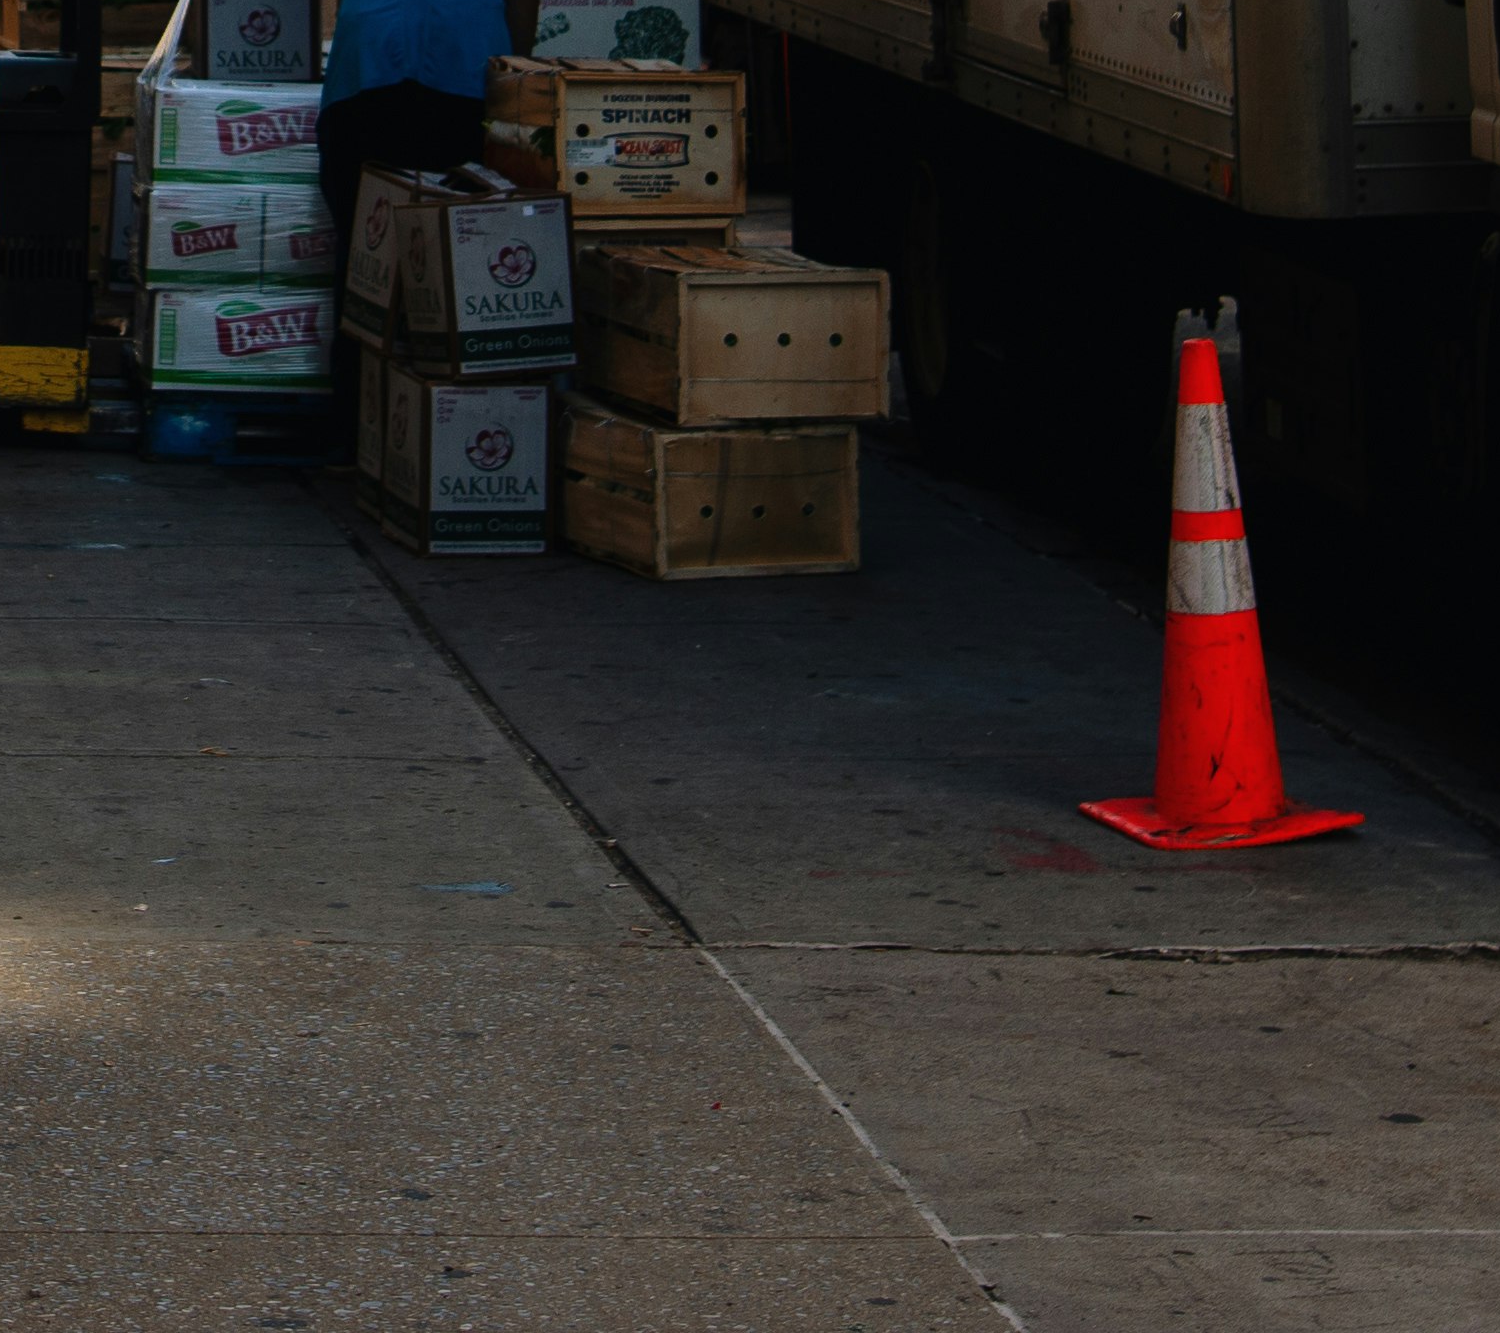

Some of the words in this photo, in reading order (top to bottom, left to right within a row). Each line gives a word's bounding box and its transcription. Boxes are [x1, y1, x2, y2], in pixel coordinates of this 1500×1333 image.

[216, 49, 305, 68] SAKURA
[601, 108, 692, 125] SPINACH
[229, 108, 308, 153] B&W
[180, 227, 229, 254] B&W
[464, 290, 566, 317] SAKURA
[227, 311, 308, 354] B&W
[464, 337, 514, 353] Green
[517, 332, 571, 349] Onions
[438, 475, 540, 497] SAKURA
[434, 518, 483, 533] Green
[487, 518, 541, 533] Onions
